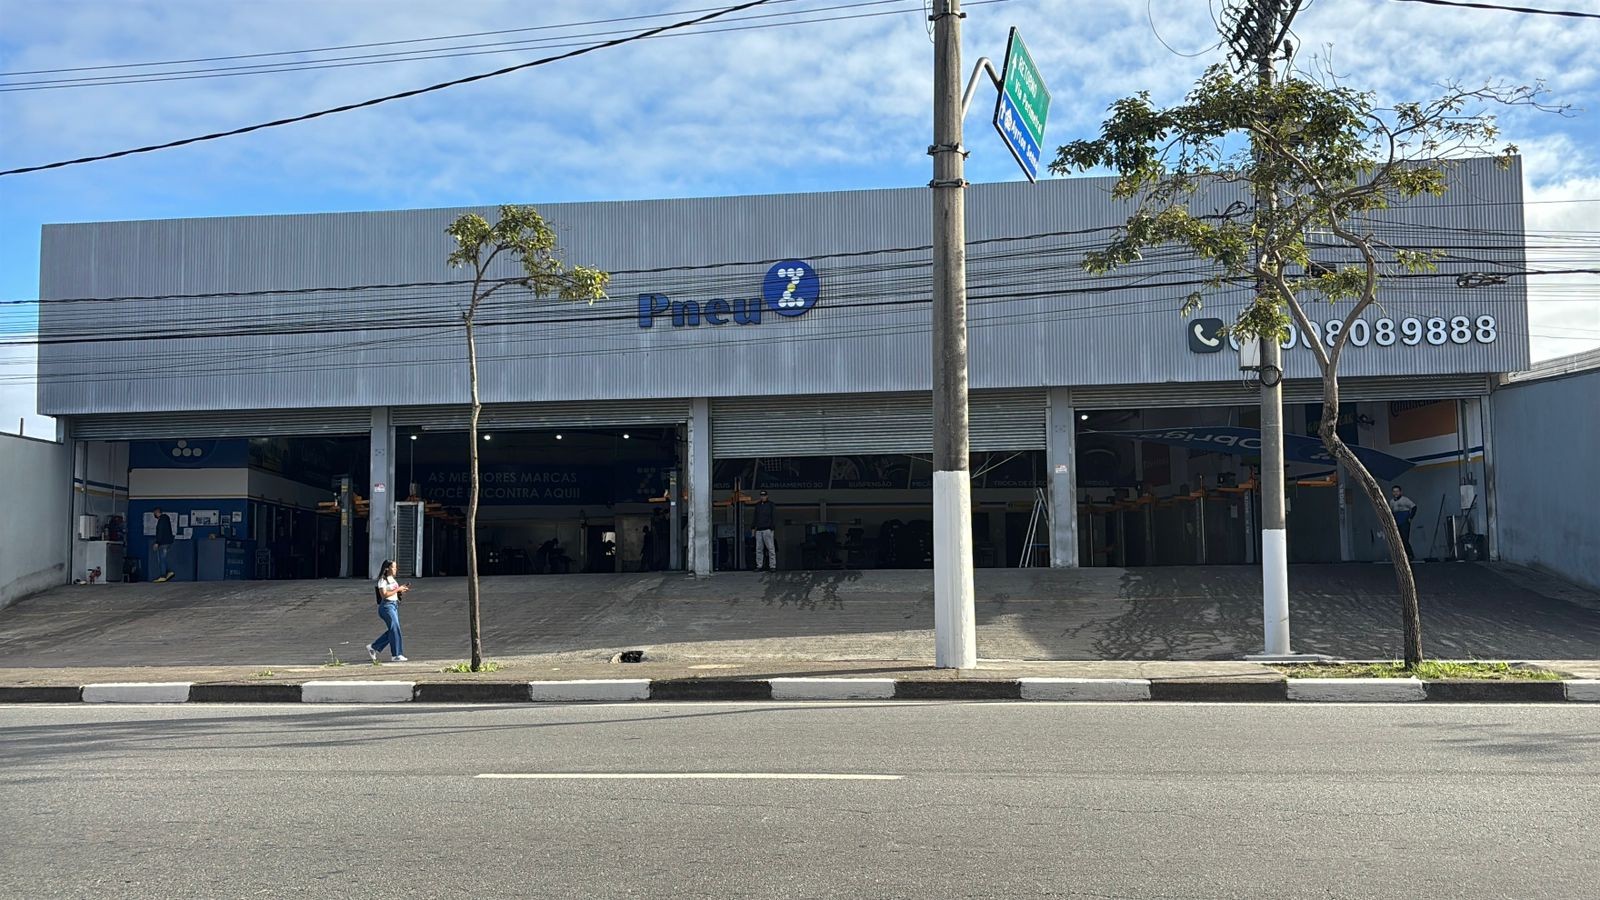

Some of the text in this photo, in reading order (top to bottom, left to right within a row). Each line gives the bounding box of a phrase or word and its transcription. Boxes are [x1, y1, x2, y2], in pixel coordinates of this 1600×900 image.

[638, 292, 762, 328] Pneu
[428, 471, 446, 483] AS
[520, 471, 577, 483] MARCAS
